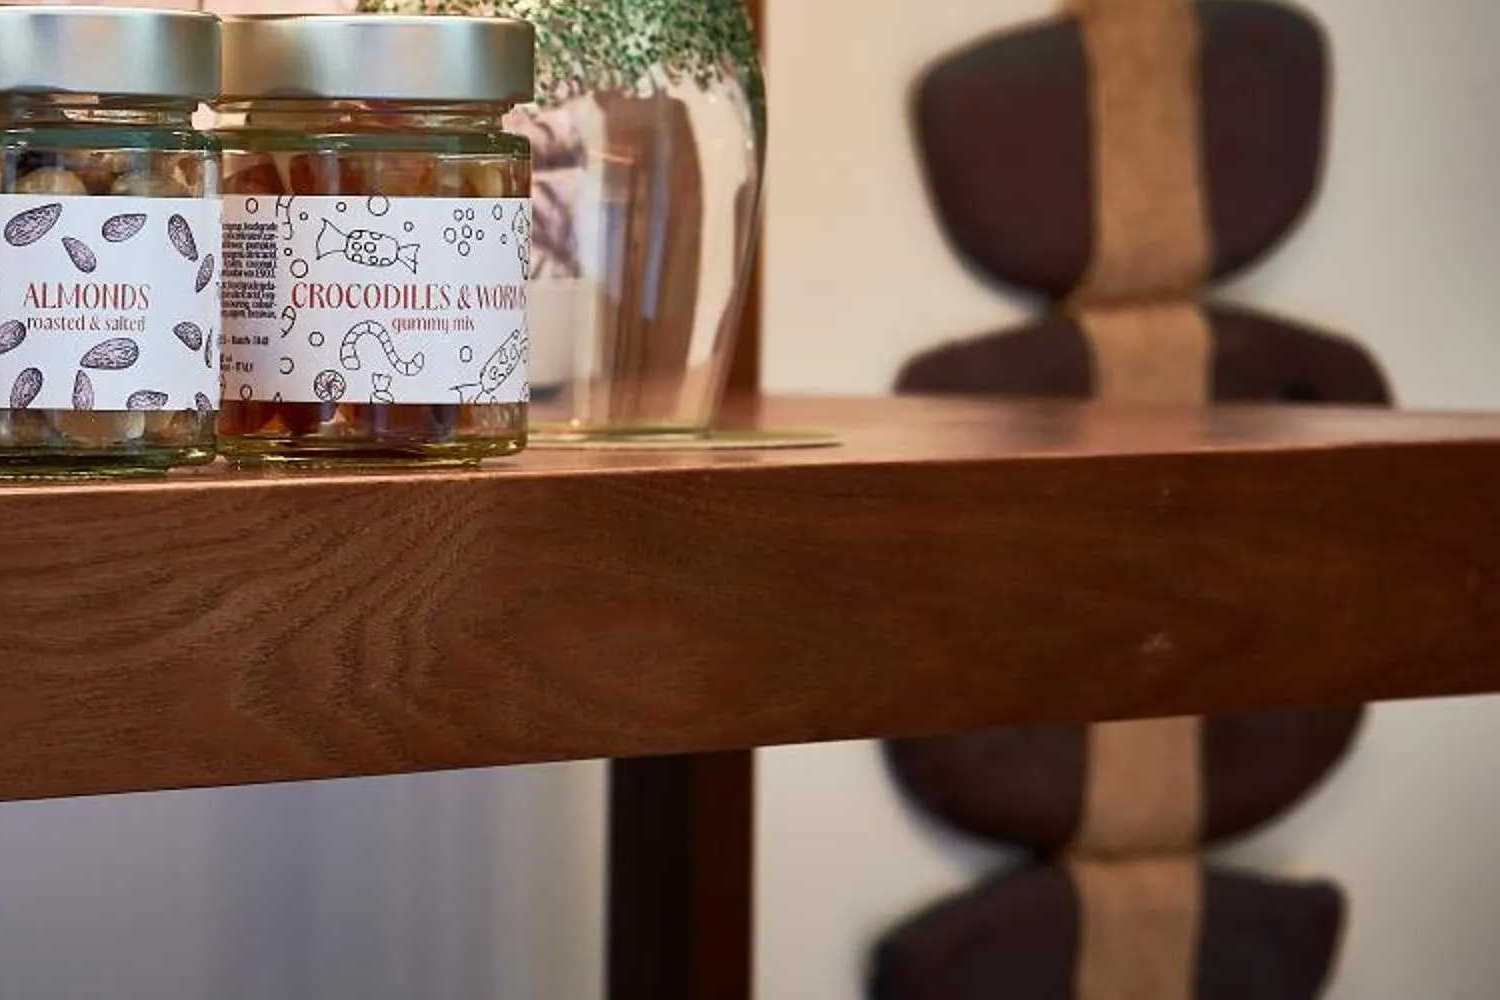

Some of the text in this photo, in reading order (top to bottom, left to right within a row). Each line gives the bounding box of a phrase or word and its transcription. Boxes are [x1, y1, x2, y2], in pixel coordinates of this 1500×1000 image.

[23, 282, 151, 311] ALMONDS
[291, 282, 451, 311] CROCODILES
[457, 284, 471, 310] &
[27, 315, 146, 332] roasted & salted
[391, 315, 475, 334] gummy mix
